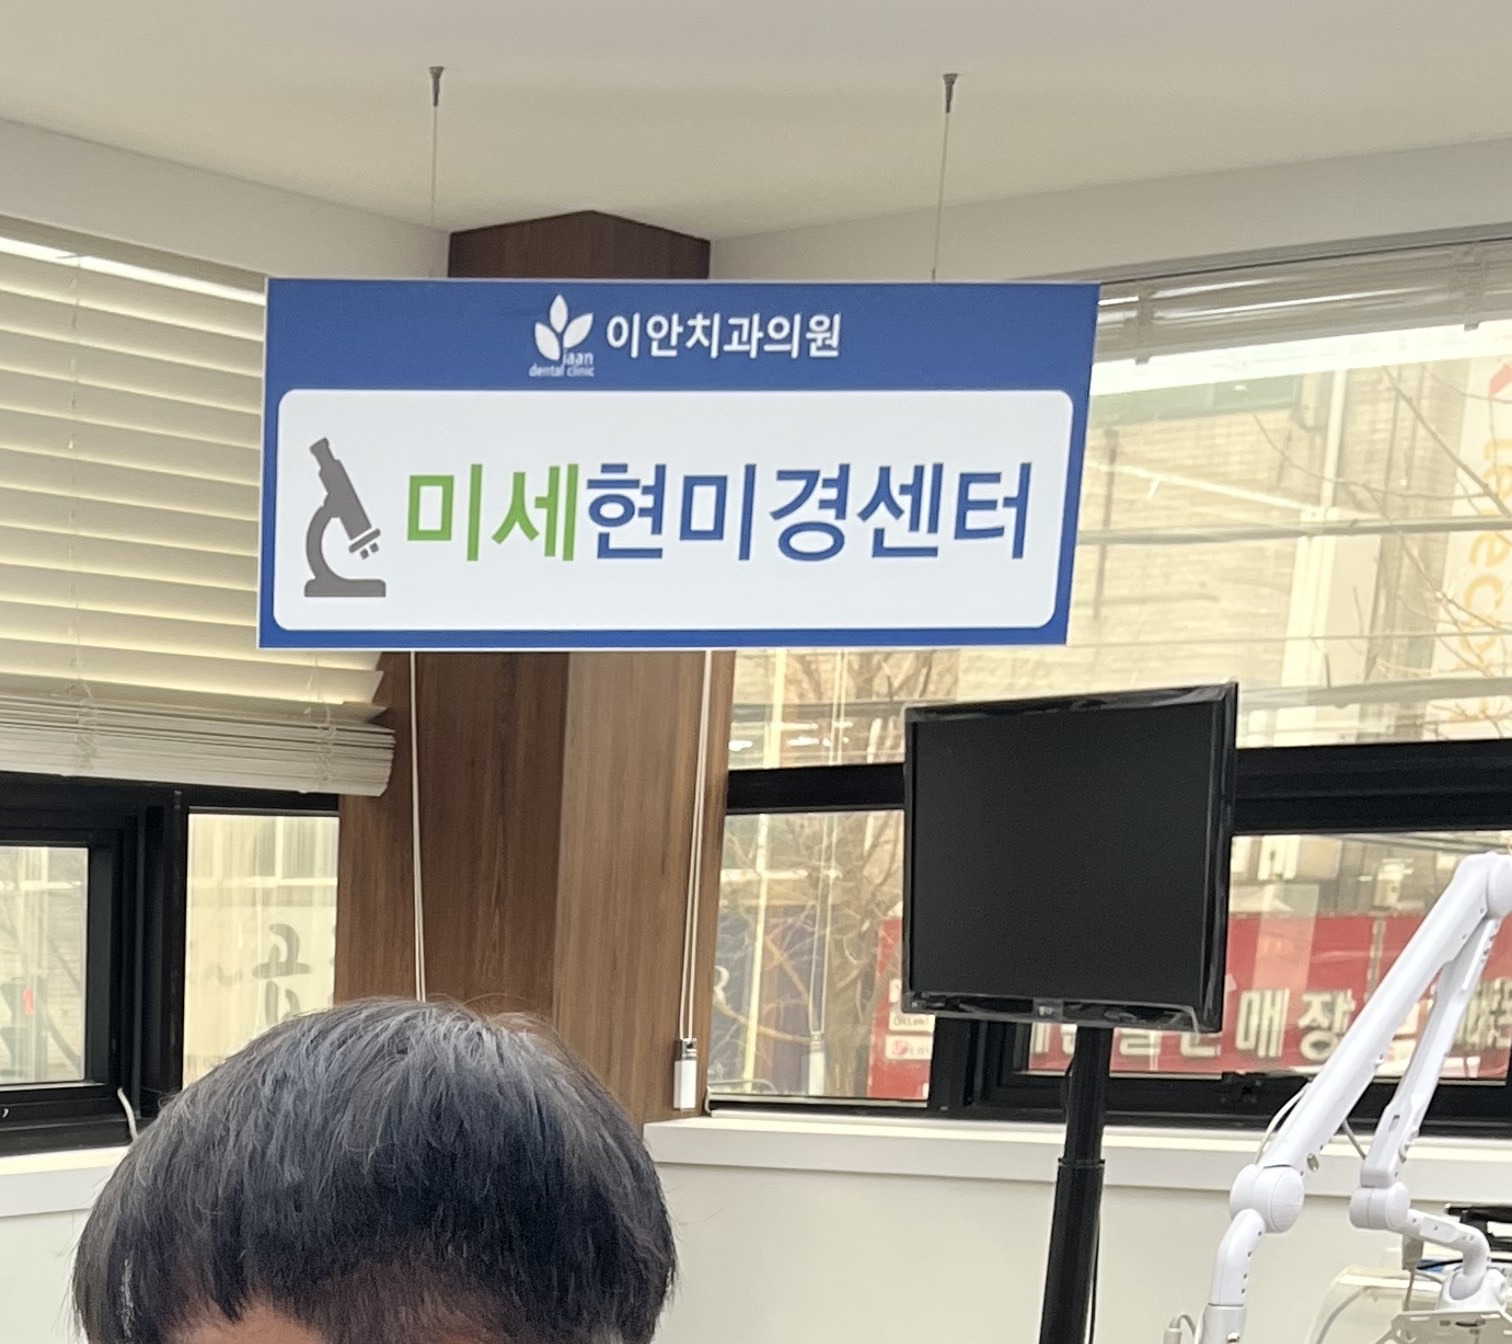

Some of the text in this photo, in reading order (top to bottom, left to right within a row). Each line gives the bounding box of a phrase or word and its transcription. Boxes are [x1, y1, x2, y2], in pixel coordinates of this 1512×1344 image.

[606, 312, 841, 359] 이안치과의원
[528, 362, 594, 377] dental clinic
[405, 461, 1034, 563] 미세현미경센터
